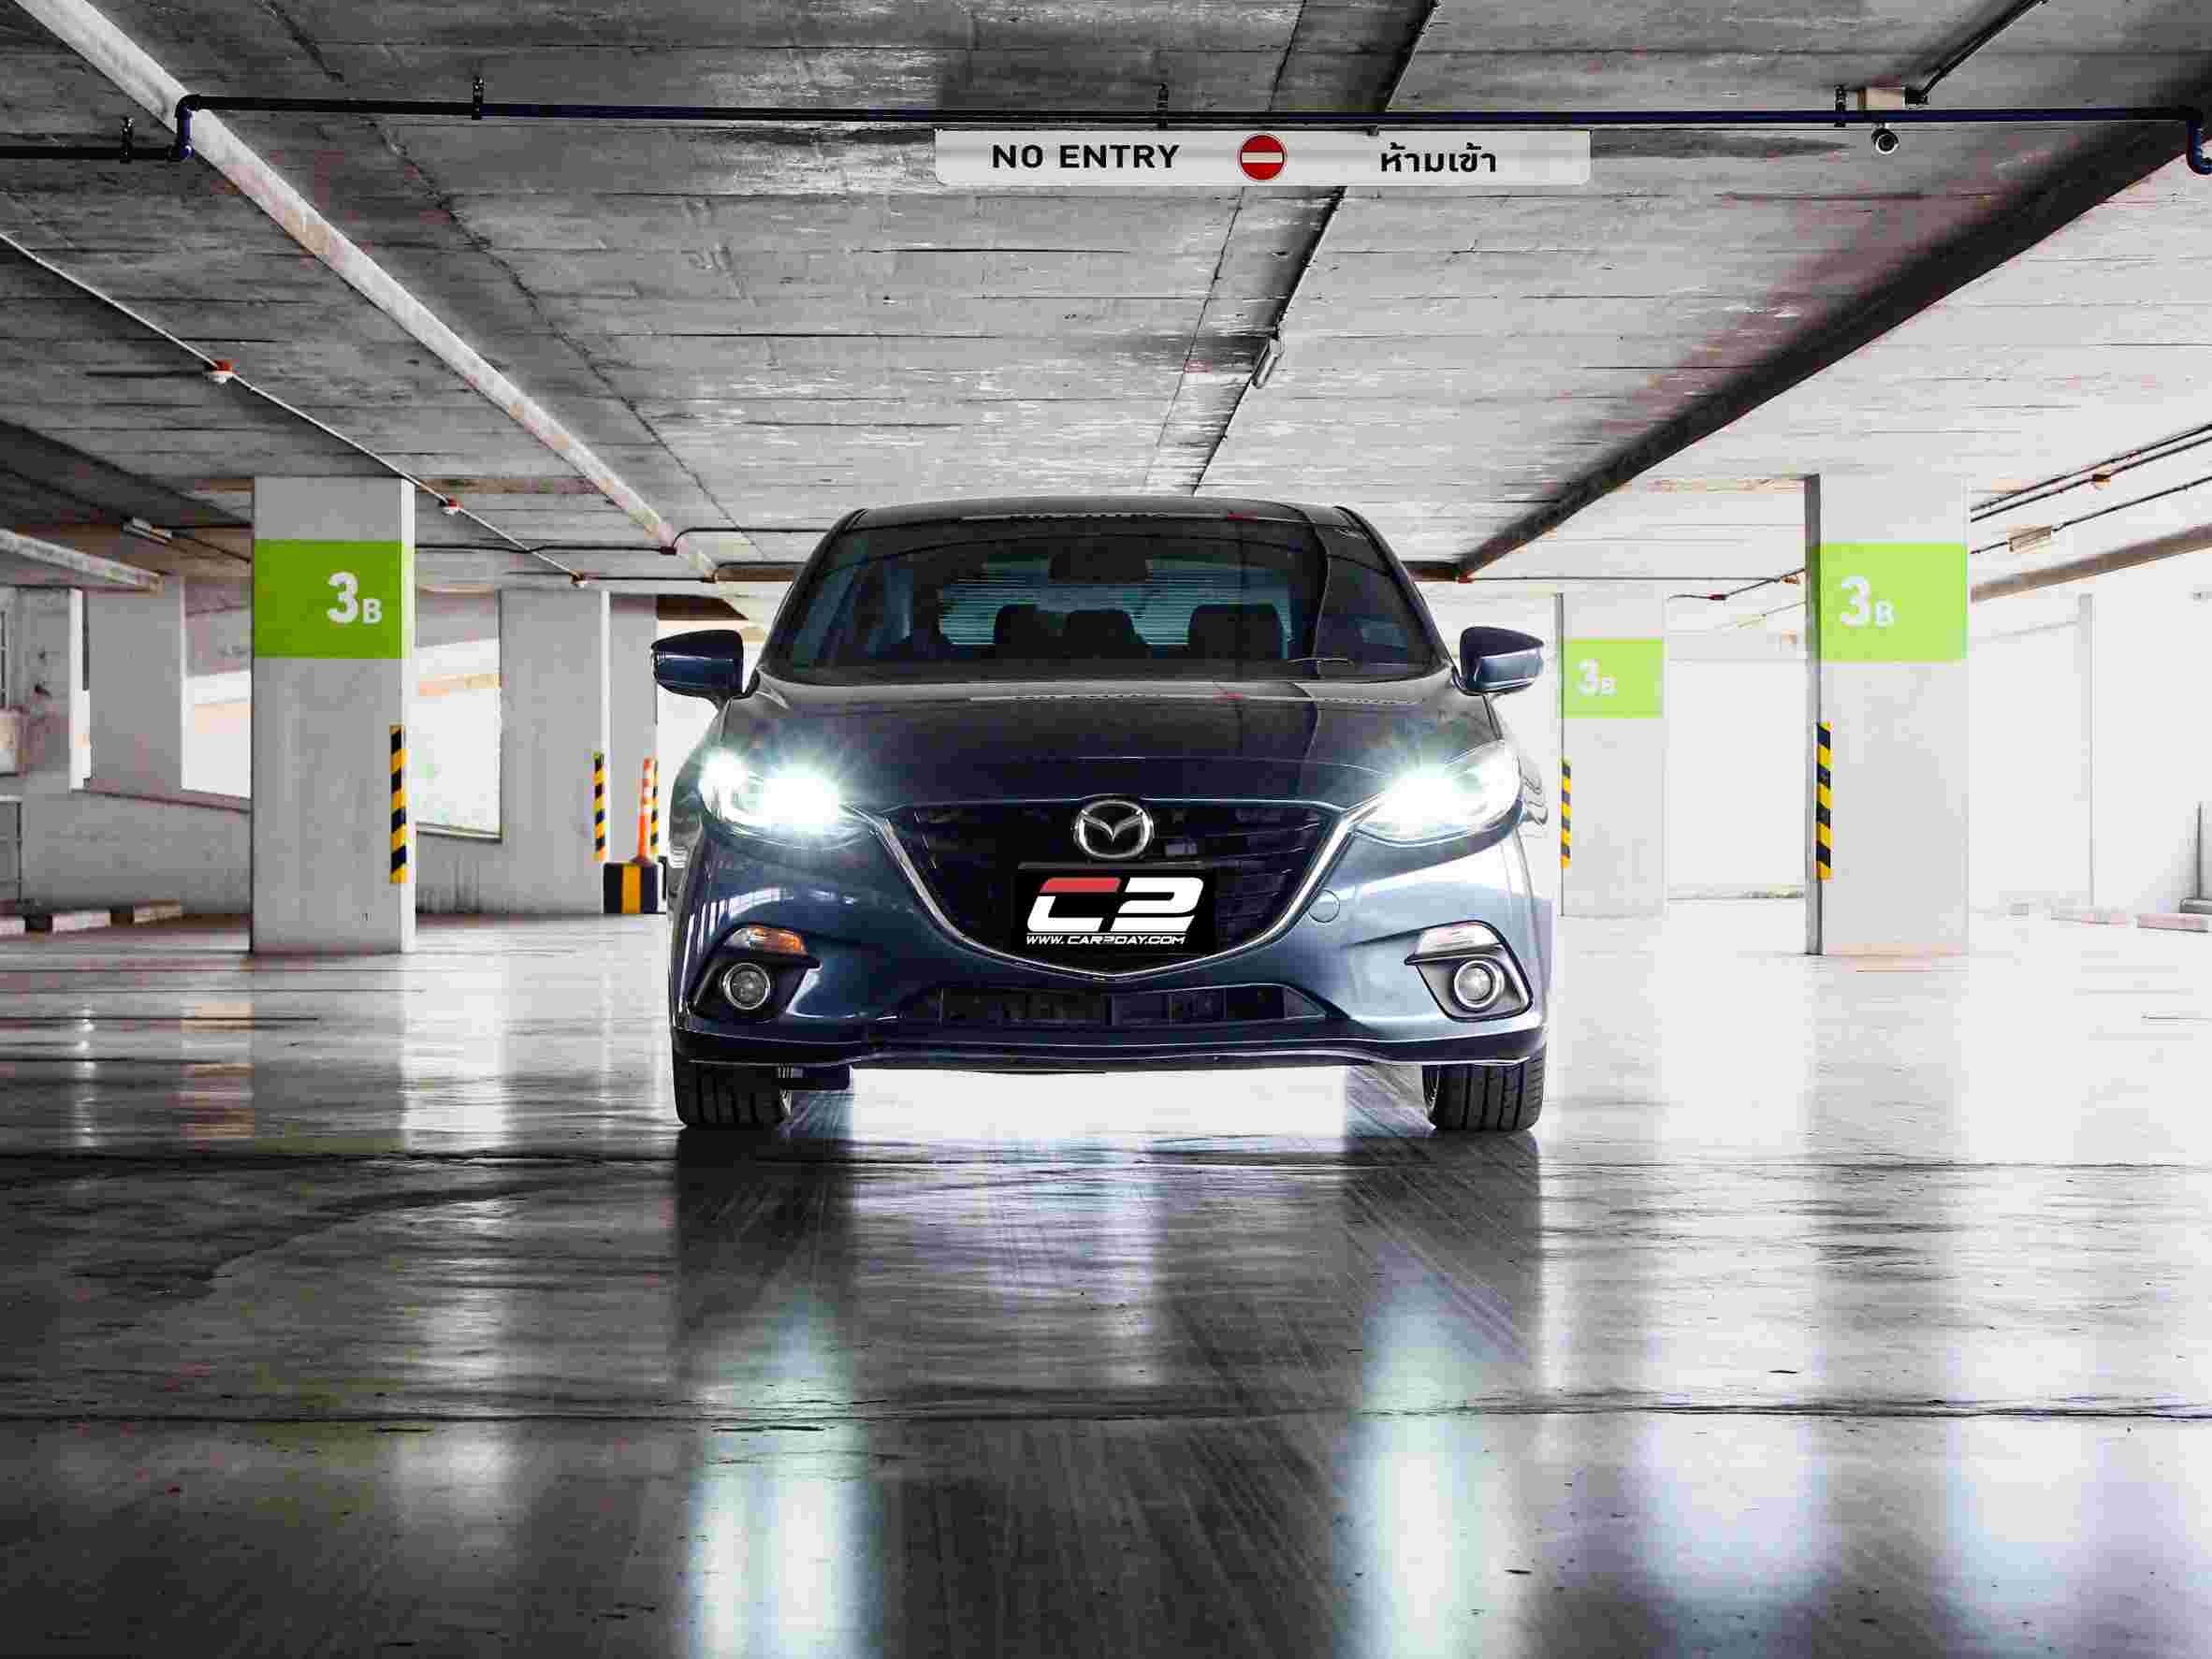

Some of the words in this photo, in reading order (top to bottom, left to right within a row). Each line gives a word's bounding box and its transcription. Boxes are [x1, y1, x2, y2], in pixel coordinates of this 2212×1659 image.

[993, 144, 1043, 168] NO
[1059, 144, 1180, 168] ENTRY
[1381, 142, 1496, 172] ห้ามเข้า
